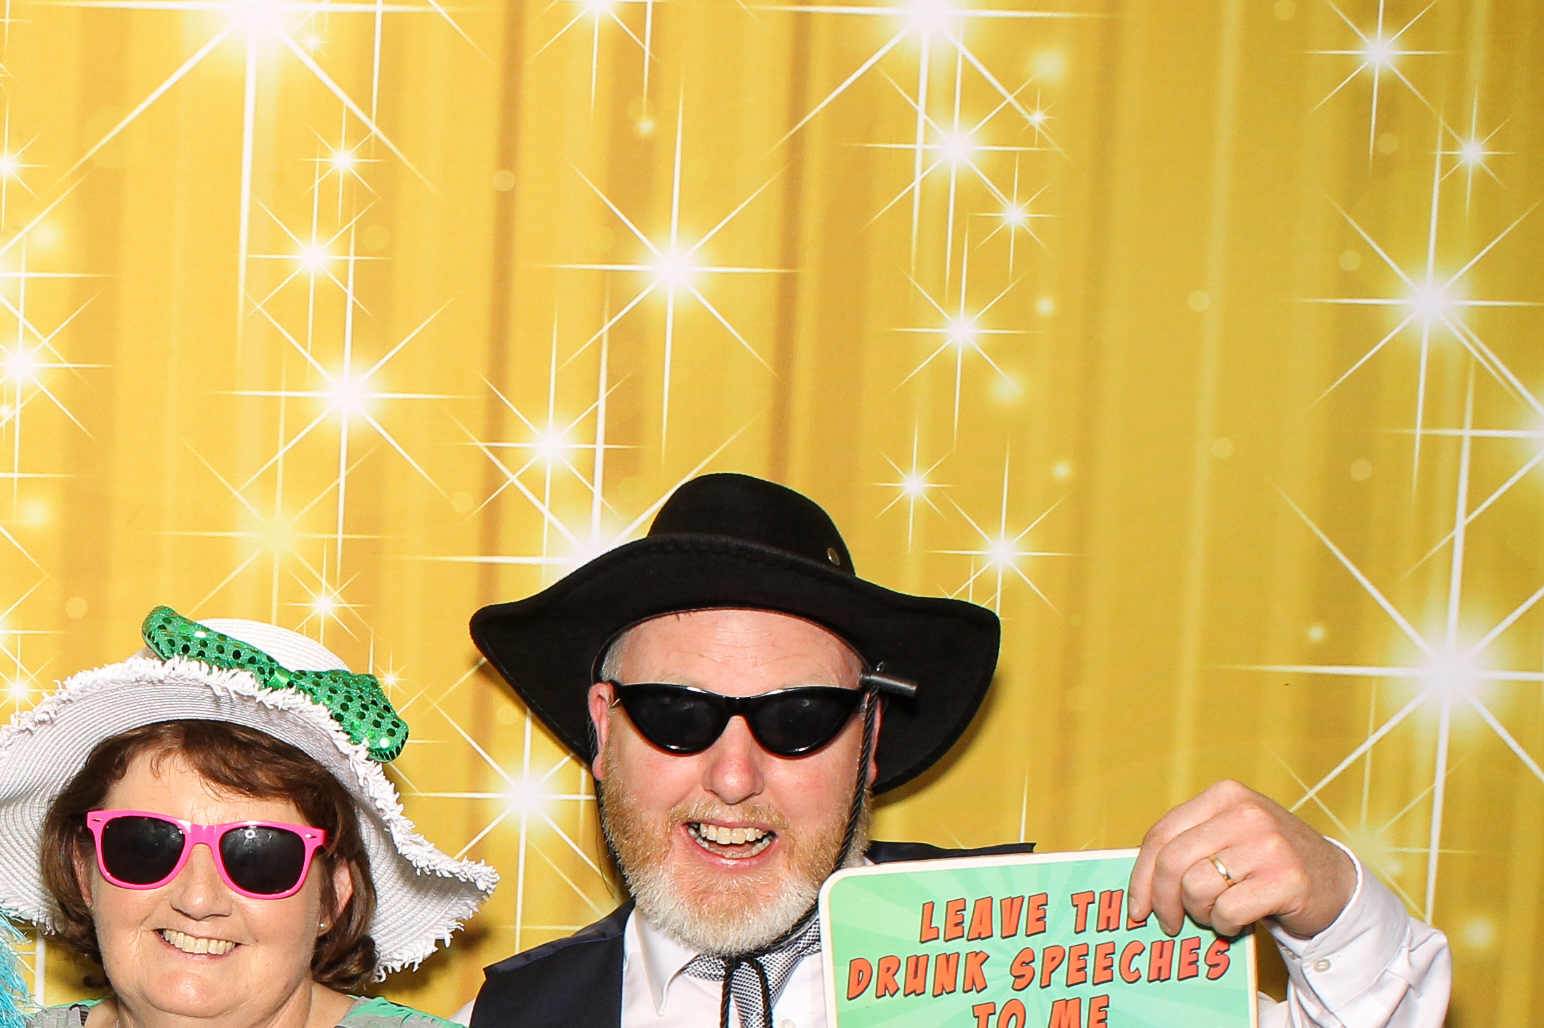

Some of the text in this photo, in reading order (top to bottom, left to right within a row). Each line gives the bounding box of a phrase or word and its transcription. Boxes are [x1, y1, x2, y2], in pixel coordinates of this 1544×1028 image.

[919, 888, 1147, 944] LEAVE TH
[846, 935, 1231, 1001] DRUNK SPEECHES
